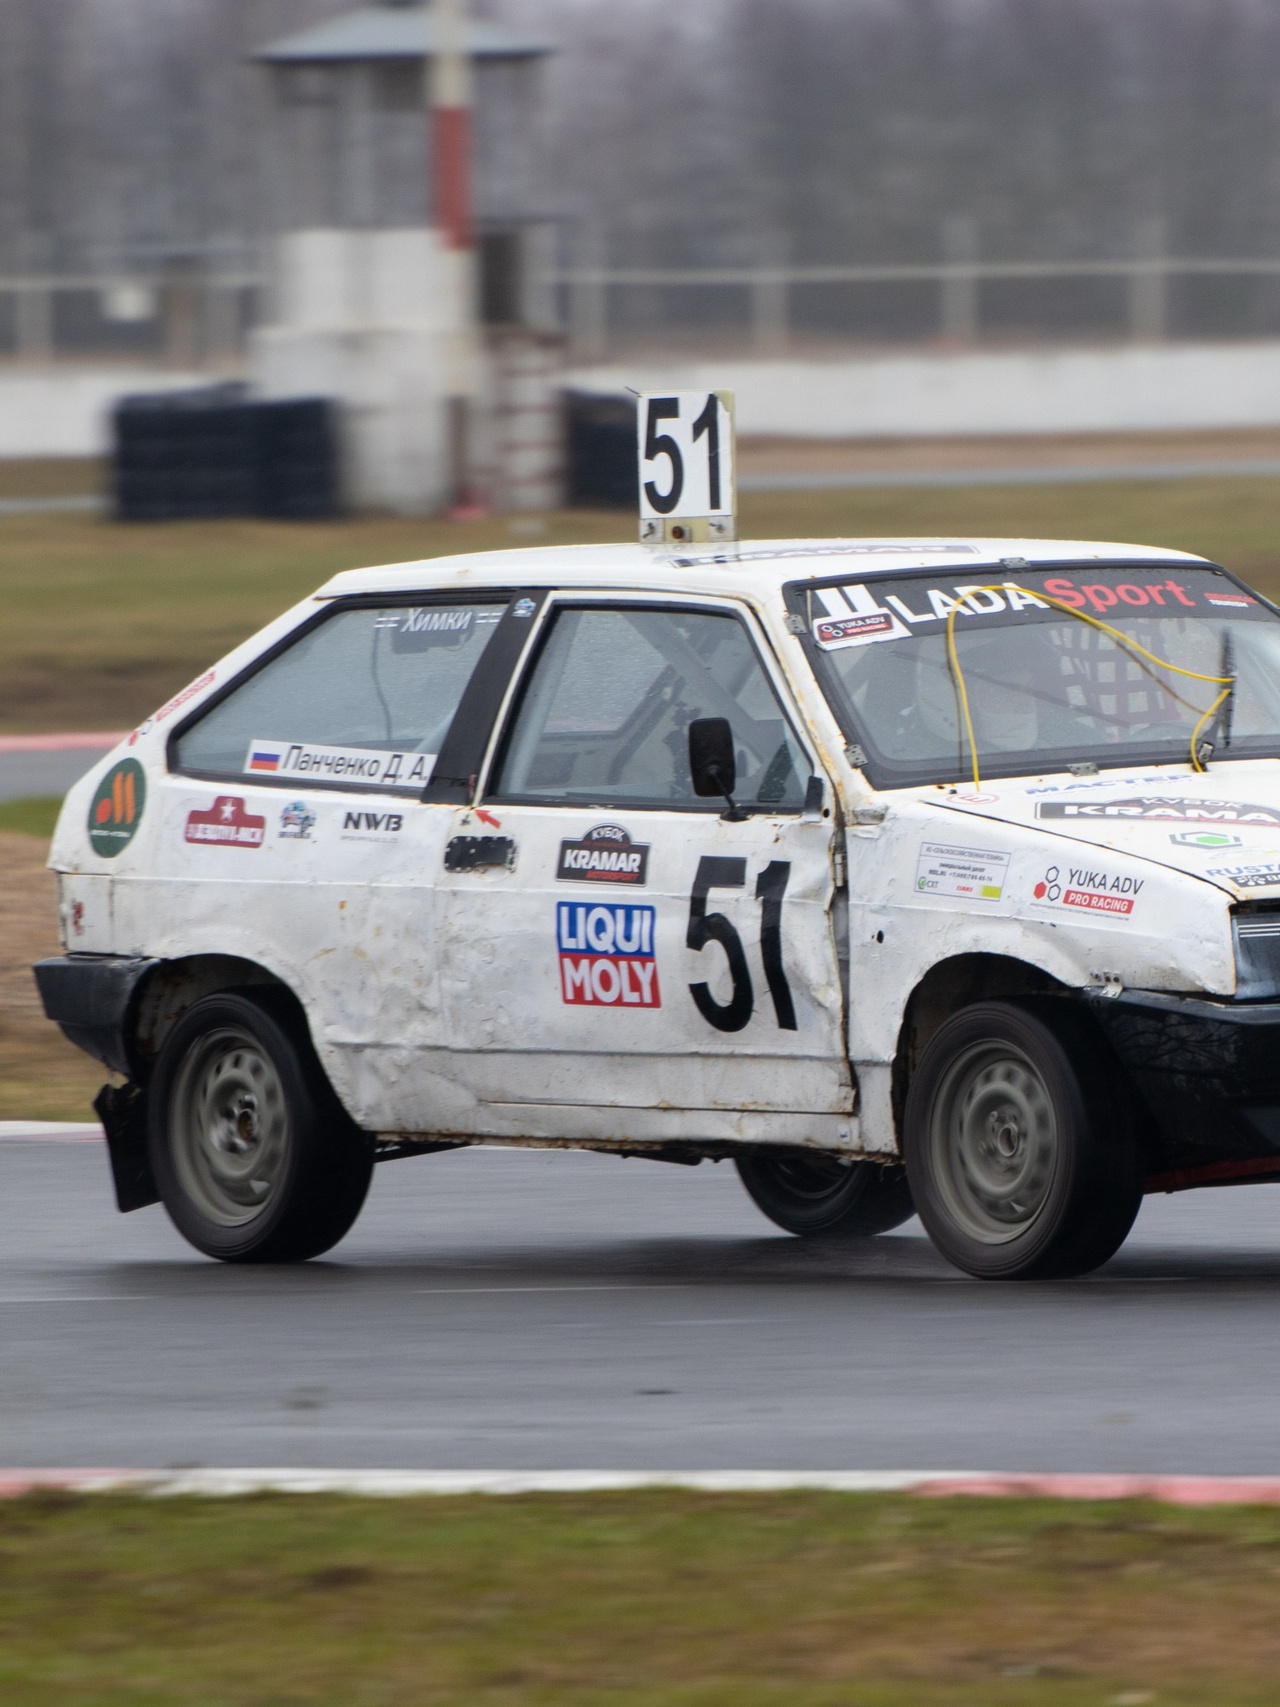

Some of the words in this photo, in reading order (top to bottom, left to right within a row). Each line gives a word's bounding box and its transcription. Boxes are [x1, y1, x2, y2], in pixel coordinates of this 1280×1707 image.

[644, 393, 721, 514] 51
[885, 582, 1051, 624] LADA
[1043, 578, 1197, 612] Sport
[836, 619, 865, 631] YUKA
[865, 615, 886, 625] ADV
[282, 745, 380, 777] Панченко
[343, 812, 403, 831] NWB
[563, 849, 642, 872] KRAMAR
[1069, 868, 1107, 890] YUKA
[1109, 876, 1145, 895] ADV
[1068, 892, 1089, 905] PRO
[1091, 897, 1129, 911] RACING
[560, 906, 651, 955] LIQUI
[686, 855, 798, 1033] 51
[562, 958, 656, 1004] MOLY
